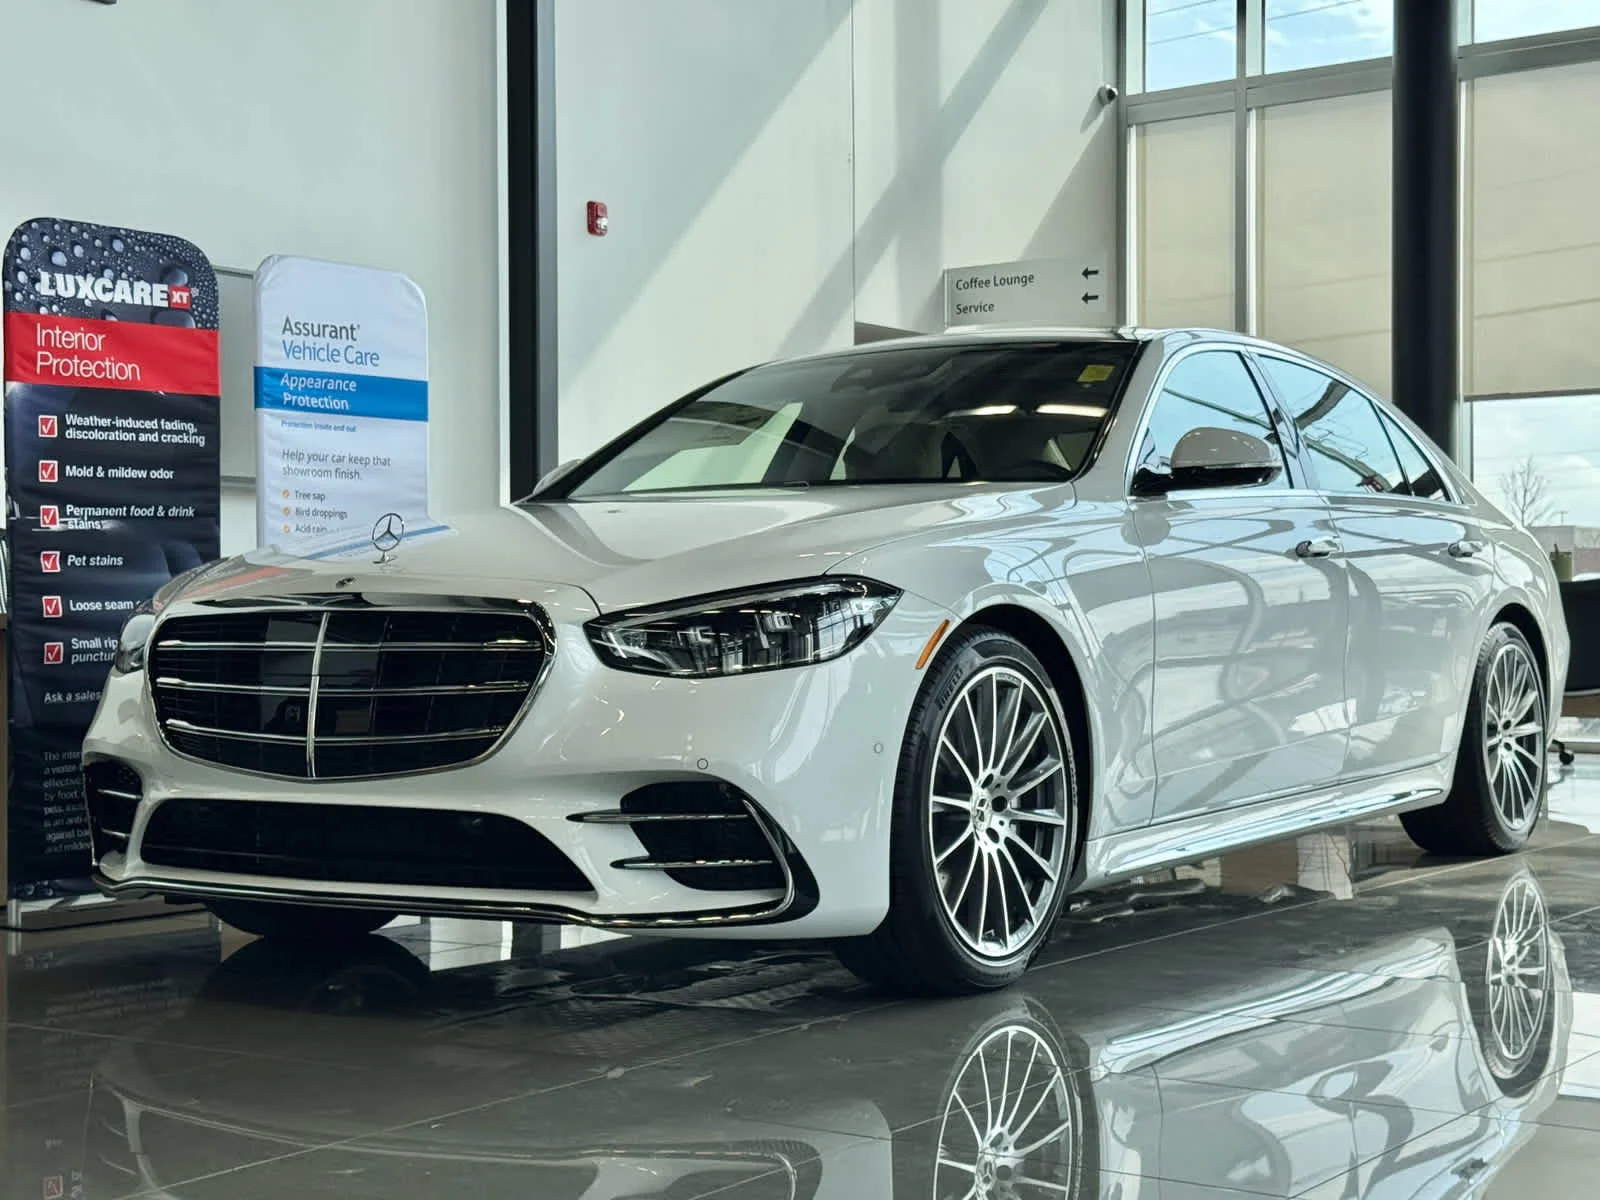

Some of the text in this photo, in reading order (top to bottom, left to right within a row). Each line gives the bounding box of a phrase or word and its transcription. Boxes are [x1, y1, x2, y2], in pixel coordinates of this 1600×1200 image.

[39, 271, 168, 308] LUXCARE
[955, 274, 1034, 291] Coffee Lounge
[955, 302, 995, 315] Service
[36, 323, 106, 351] Interior
[282, 340, 380, 367] Vehicle Care
[36, 351, 141, 381] Protection
[280, 372, 358, 392] Appearance
[282, 392, 350, 410] Protection
[65, 413, 158, 430] Weather-induced
[65, 427, 206, 448] discoloration and cracking
[281, 449, 391, 468] Help your car keep that
[65, 465, 175, 480] Mold & mildew odor
[282, 465, 332, 480] showroom
[295, 490, 325, 504] Tree sap
[66, 504, 196, 518] Permanent food & drink
[295, 507, 348, 520] Bird droppings
[67, 555, 124, 566] Pet stains
[69, 600, 102, 611] Loose
[104, 600, 134, 610] seam
[71, 637, 102, 649] Small
[44, 691, 63, 704] Ask
[65, 692, 73, 702] a
